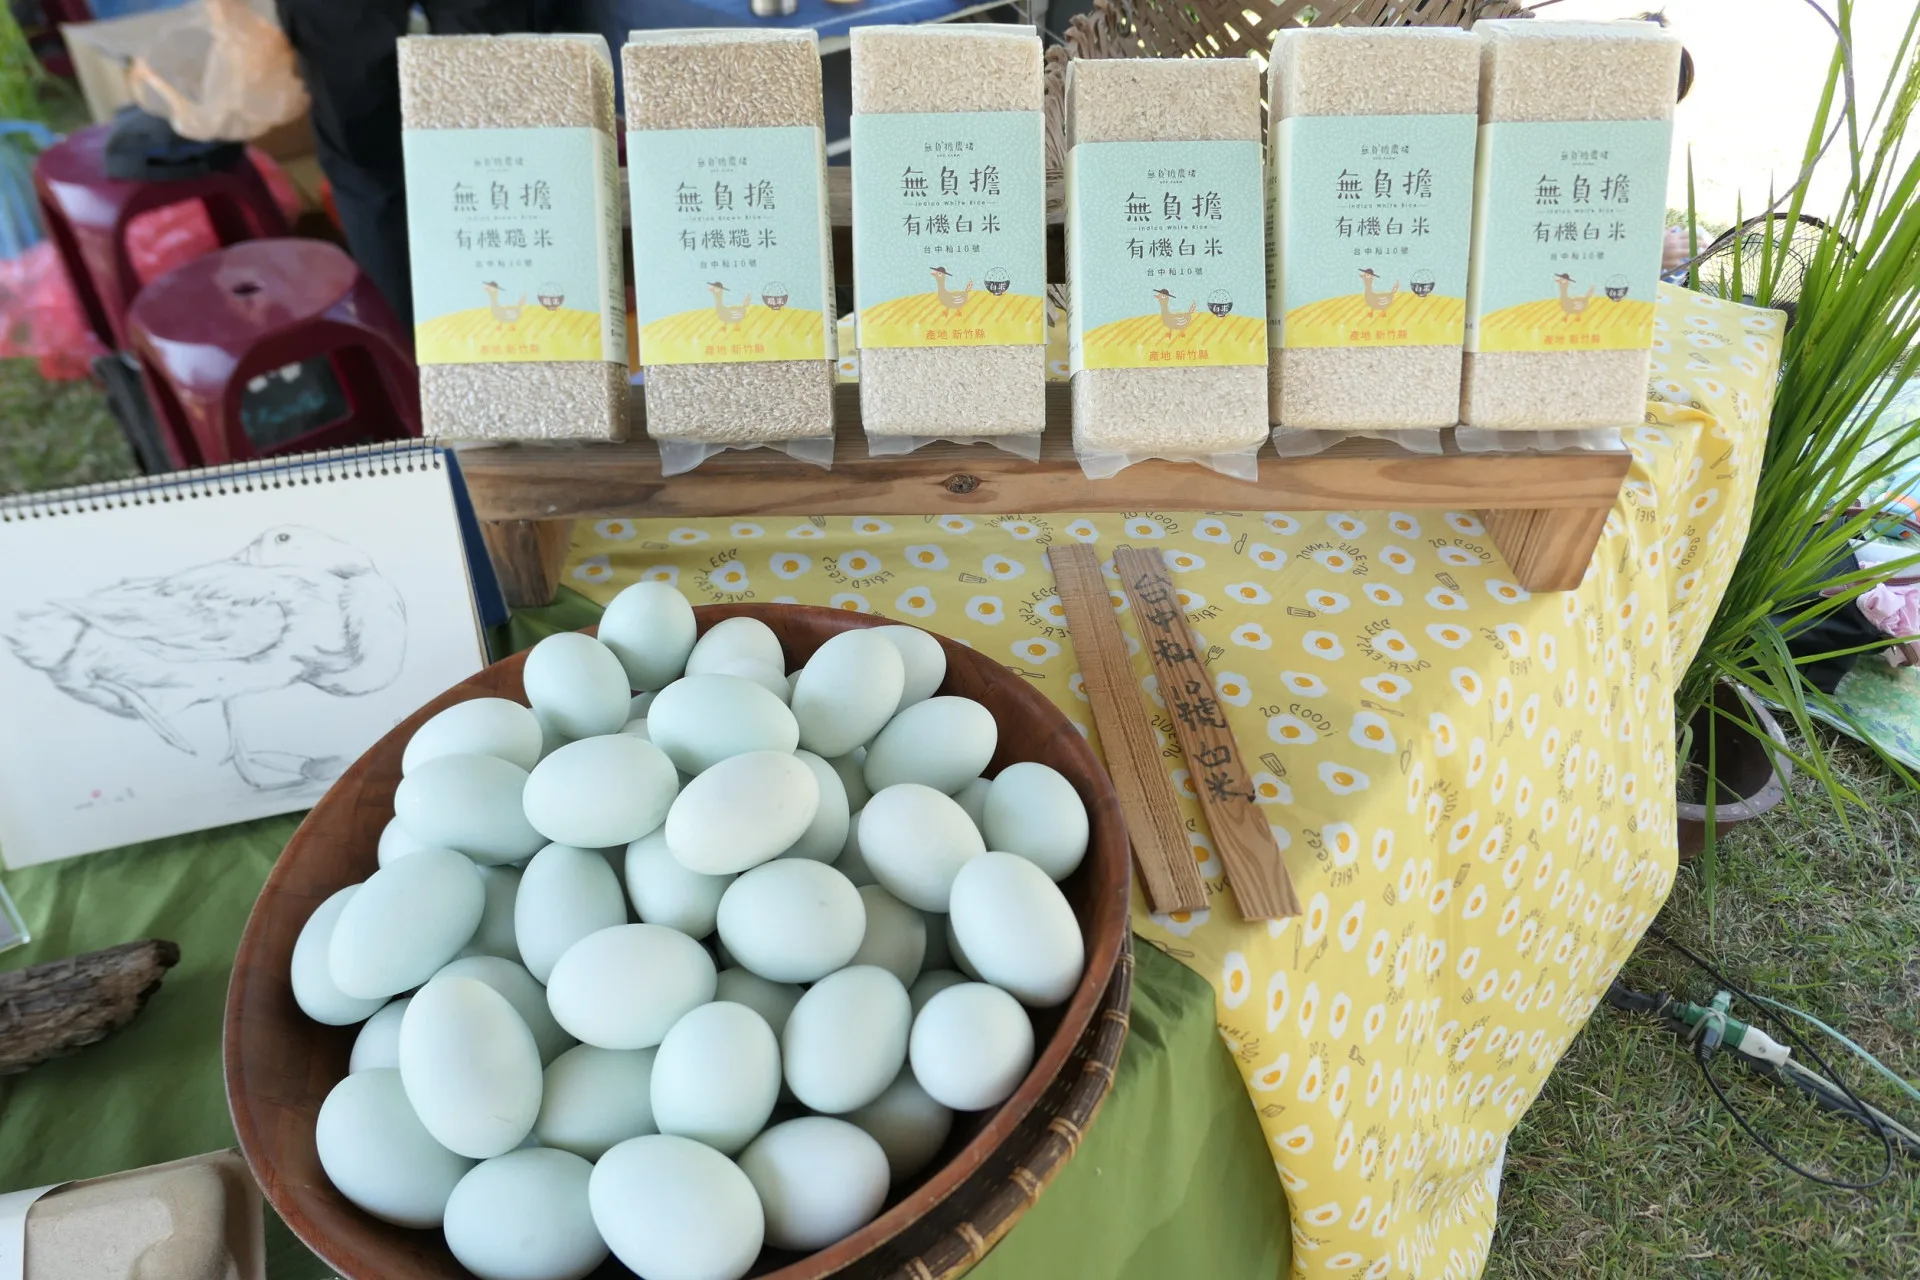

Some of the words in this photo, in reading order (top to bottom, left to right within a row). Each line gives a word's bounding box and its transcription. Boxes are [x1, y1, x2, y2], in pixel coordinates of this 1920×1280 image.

[900, 164, 1001, 198] 無負擔
[1336, 167, 1433, 200] 無負擔
[1535, 172, 1631, 205] 無負擔
[453, 180, 552, 212] 無負擔
[675, 180, 776, 212] 無負擔
[1124, 190, 1223, 222] 無負擔
[902, 213, 1001, 236] 有機白米
[1335, 215, 1430, 238] 有機白米
[1532, 221, 1626, 242] 有機白米
[454, 228, 554, 251] 有機糙米
[679, 227, 777, 251] 有機糙米
[1125, 237, 1224, 259] 有機白米
[925, 329, 948, 341] 產地
[952, 328, 986, 340] 新竹縣
[1350, 331, 1372, 341] 產地
[1149, 350, 1171, 362] 產地
[1175, 349, 1209, 361] 新竹縣
